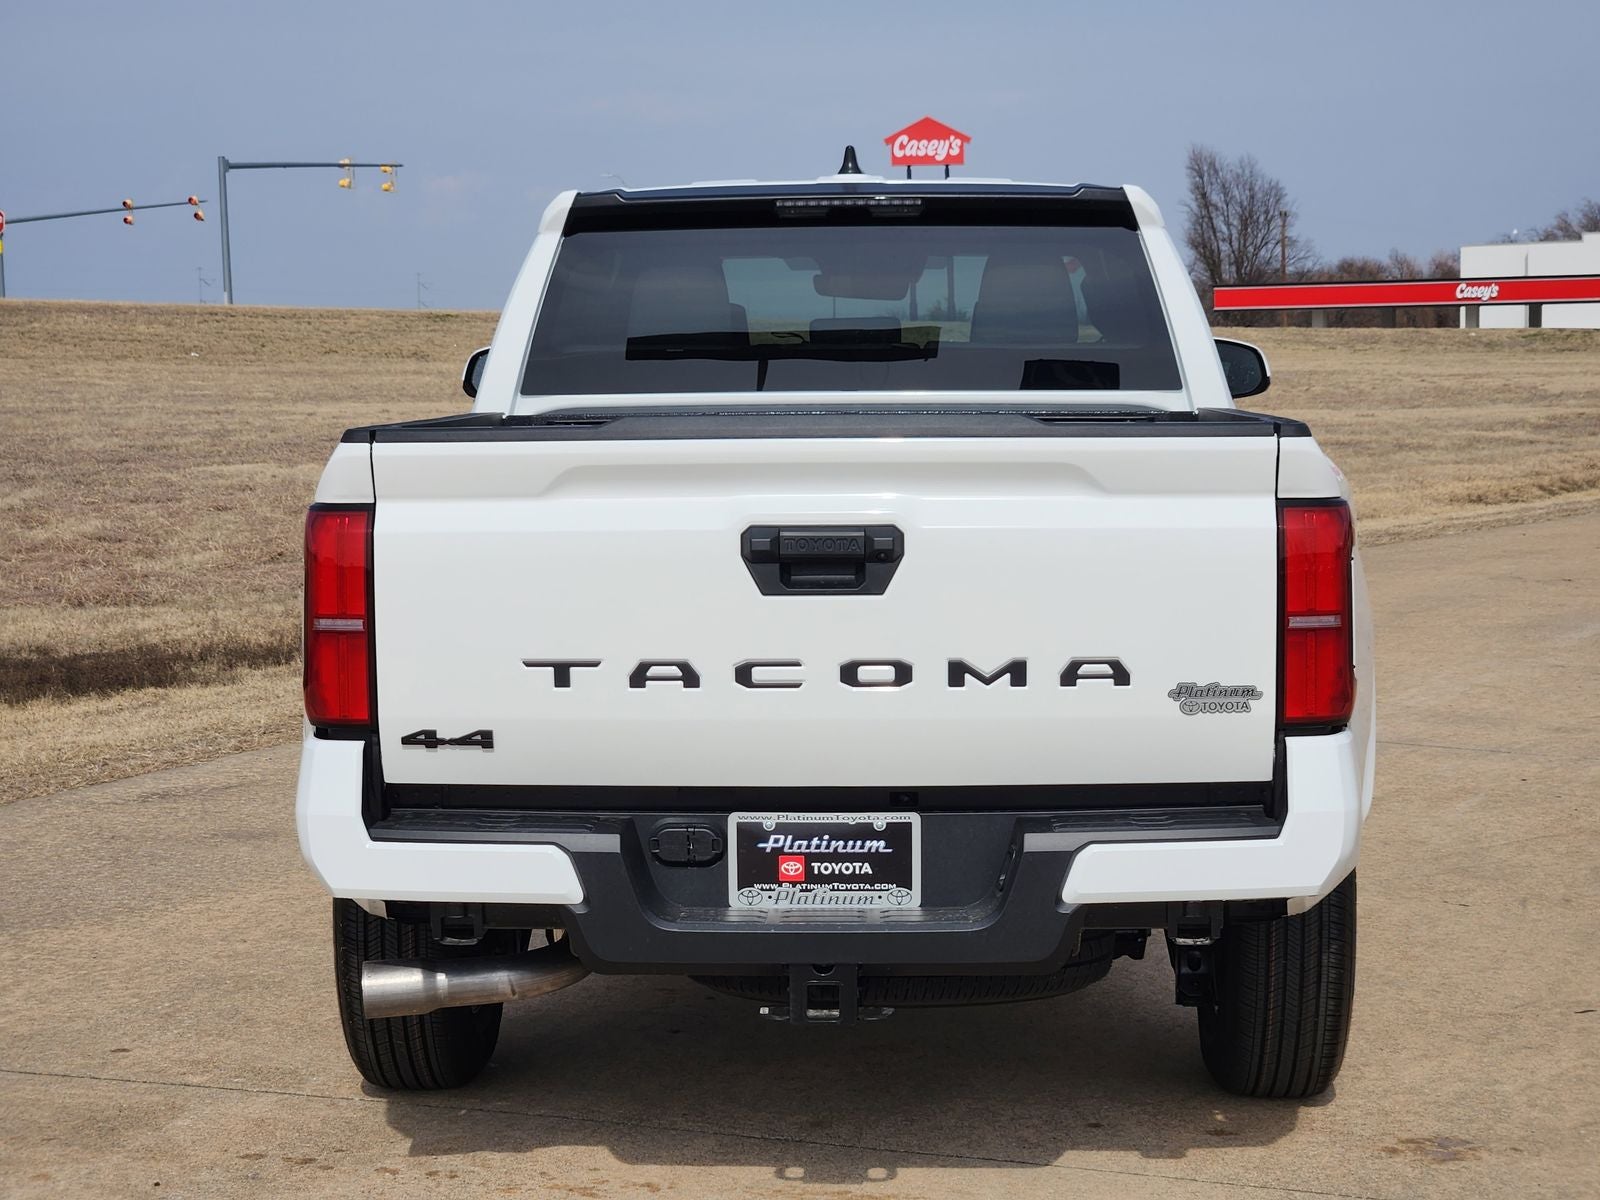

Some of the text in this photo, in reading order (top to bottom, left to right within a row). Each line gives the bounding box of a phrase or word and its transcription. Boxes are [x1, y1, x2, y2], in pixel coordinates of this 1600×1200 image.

[893, 134, 962, 161] Casey's
[1455, 283, 1500, 301] Casey's
[783, 537, 862, 552] TOYOTA
[521, 656, 1132, 689] TACOMA
[1172, 684, 1260, 698] Platinum
[1201, 701, 1250, 711] TOYOTA
[737, 814, 911, 822] www.PlatinumToyota.com
[757, 834, 893, 853] Platinum
[811, 862, 873, 875] TOYOTA
[754, 882, 897, 890] WWWPLATINUMTOYOTA.COM
[773, 890, 883, 905] Platinum
